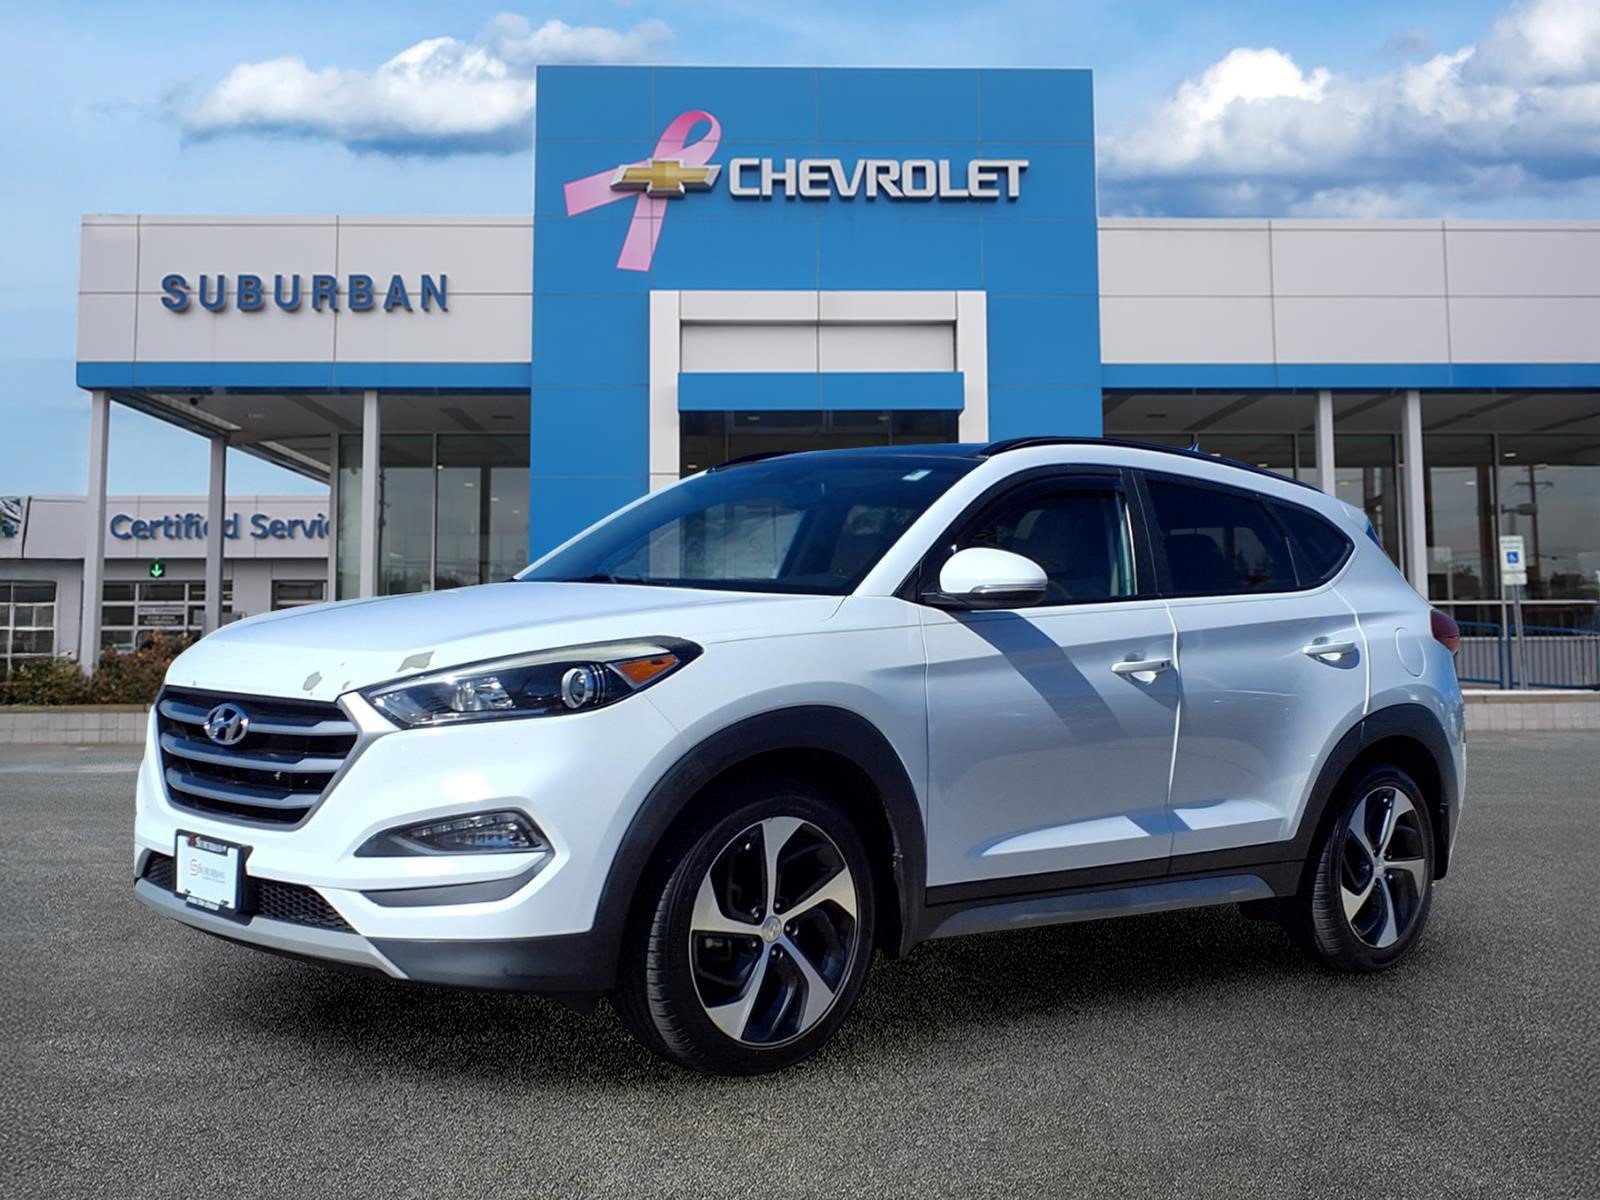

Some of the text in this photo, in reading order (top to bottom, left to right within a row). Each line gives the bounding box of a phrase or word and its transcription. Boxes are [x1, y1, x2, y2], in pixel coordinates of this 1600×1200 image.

[729, 157, 1029, 200] CHEVROLET
[161, 273, 449, 313] SUBURBAN
[110, 512, 330, 540] Certifid Servi
